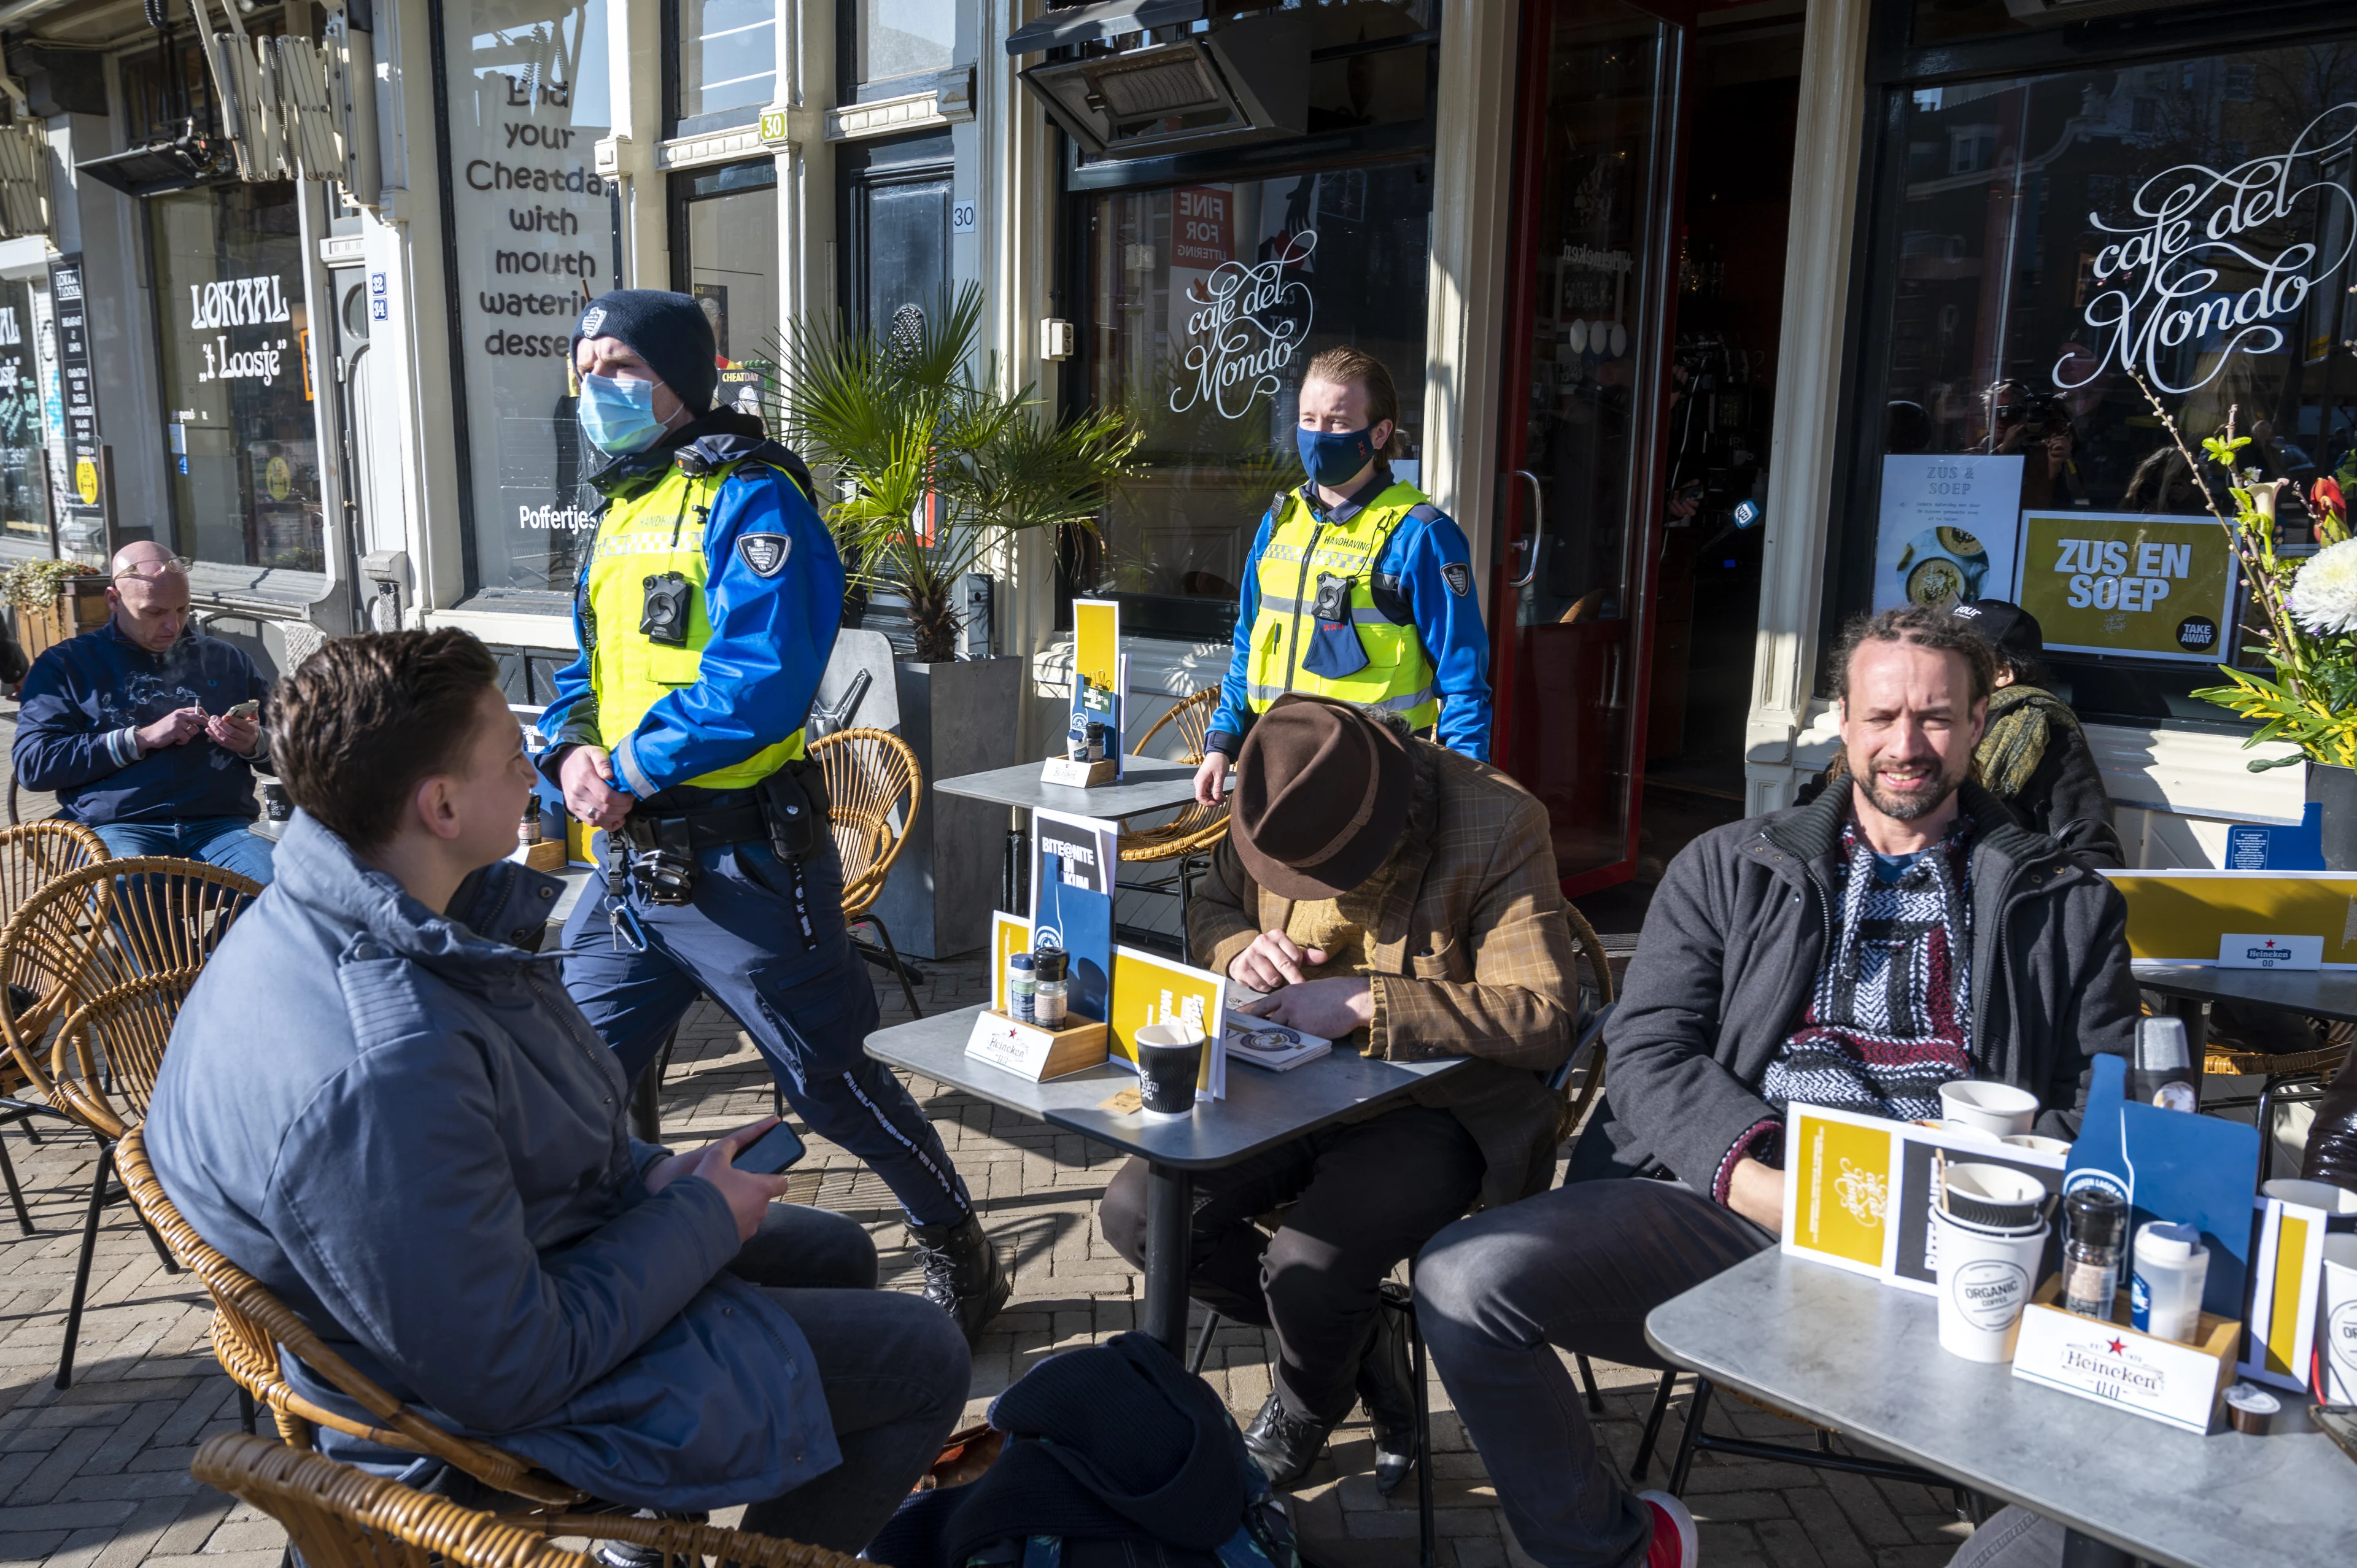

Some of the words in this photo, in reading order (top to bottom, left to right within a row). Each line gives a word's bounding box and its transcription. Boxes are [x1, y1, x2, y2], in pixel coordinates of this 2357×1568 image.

[506, 75, 568, 107] End
[504, 123, 575, 150] your
[765, 115, 782, 137] 30
[509, 205, 578, 236] with
[954, 207, 973, 226] 30
[497, 250, 595, 277] mouth
[373, 277, 384, 292] 32
[374, 302, 385, 316] 34
[480, 290, 588, 316] wateri
[2052, 242, 2318, 393] Mondo
[722, 372, 759, 382] CHEATDAY
[1170, 319, 1296, 419] Mondo
[1927, 467, 1957, 479] ZUS
[1965, 468, 1974, 479] &
[1929, 482, 1971, 495] SOEP
[519, 504, 598, 535] Poffertjes
[1324, 536, 1371, 551] HANDHAVING
[2054, 538, 2129, 576] ZUS
[2136, 542, 2193, 579] EN
[2067, 574, 2170, 612] SOEP
[2181, 633, 2212, 644] AWAY
[2183, 624, 2212, 634] TAKE
[1042, 836, 1094, 865] BITE@NITE
[1064, 857, 1075, 873] IN
[989, 1037, 1024, 1059] Heineken
[1965, 1280, 2018, 1299] ORGANIC
[2067, 1351, 2156, 1389] Heineken
